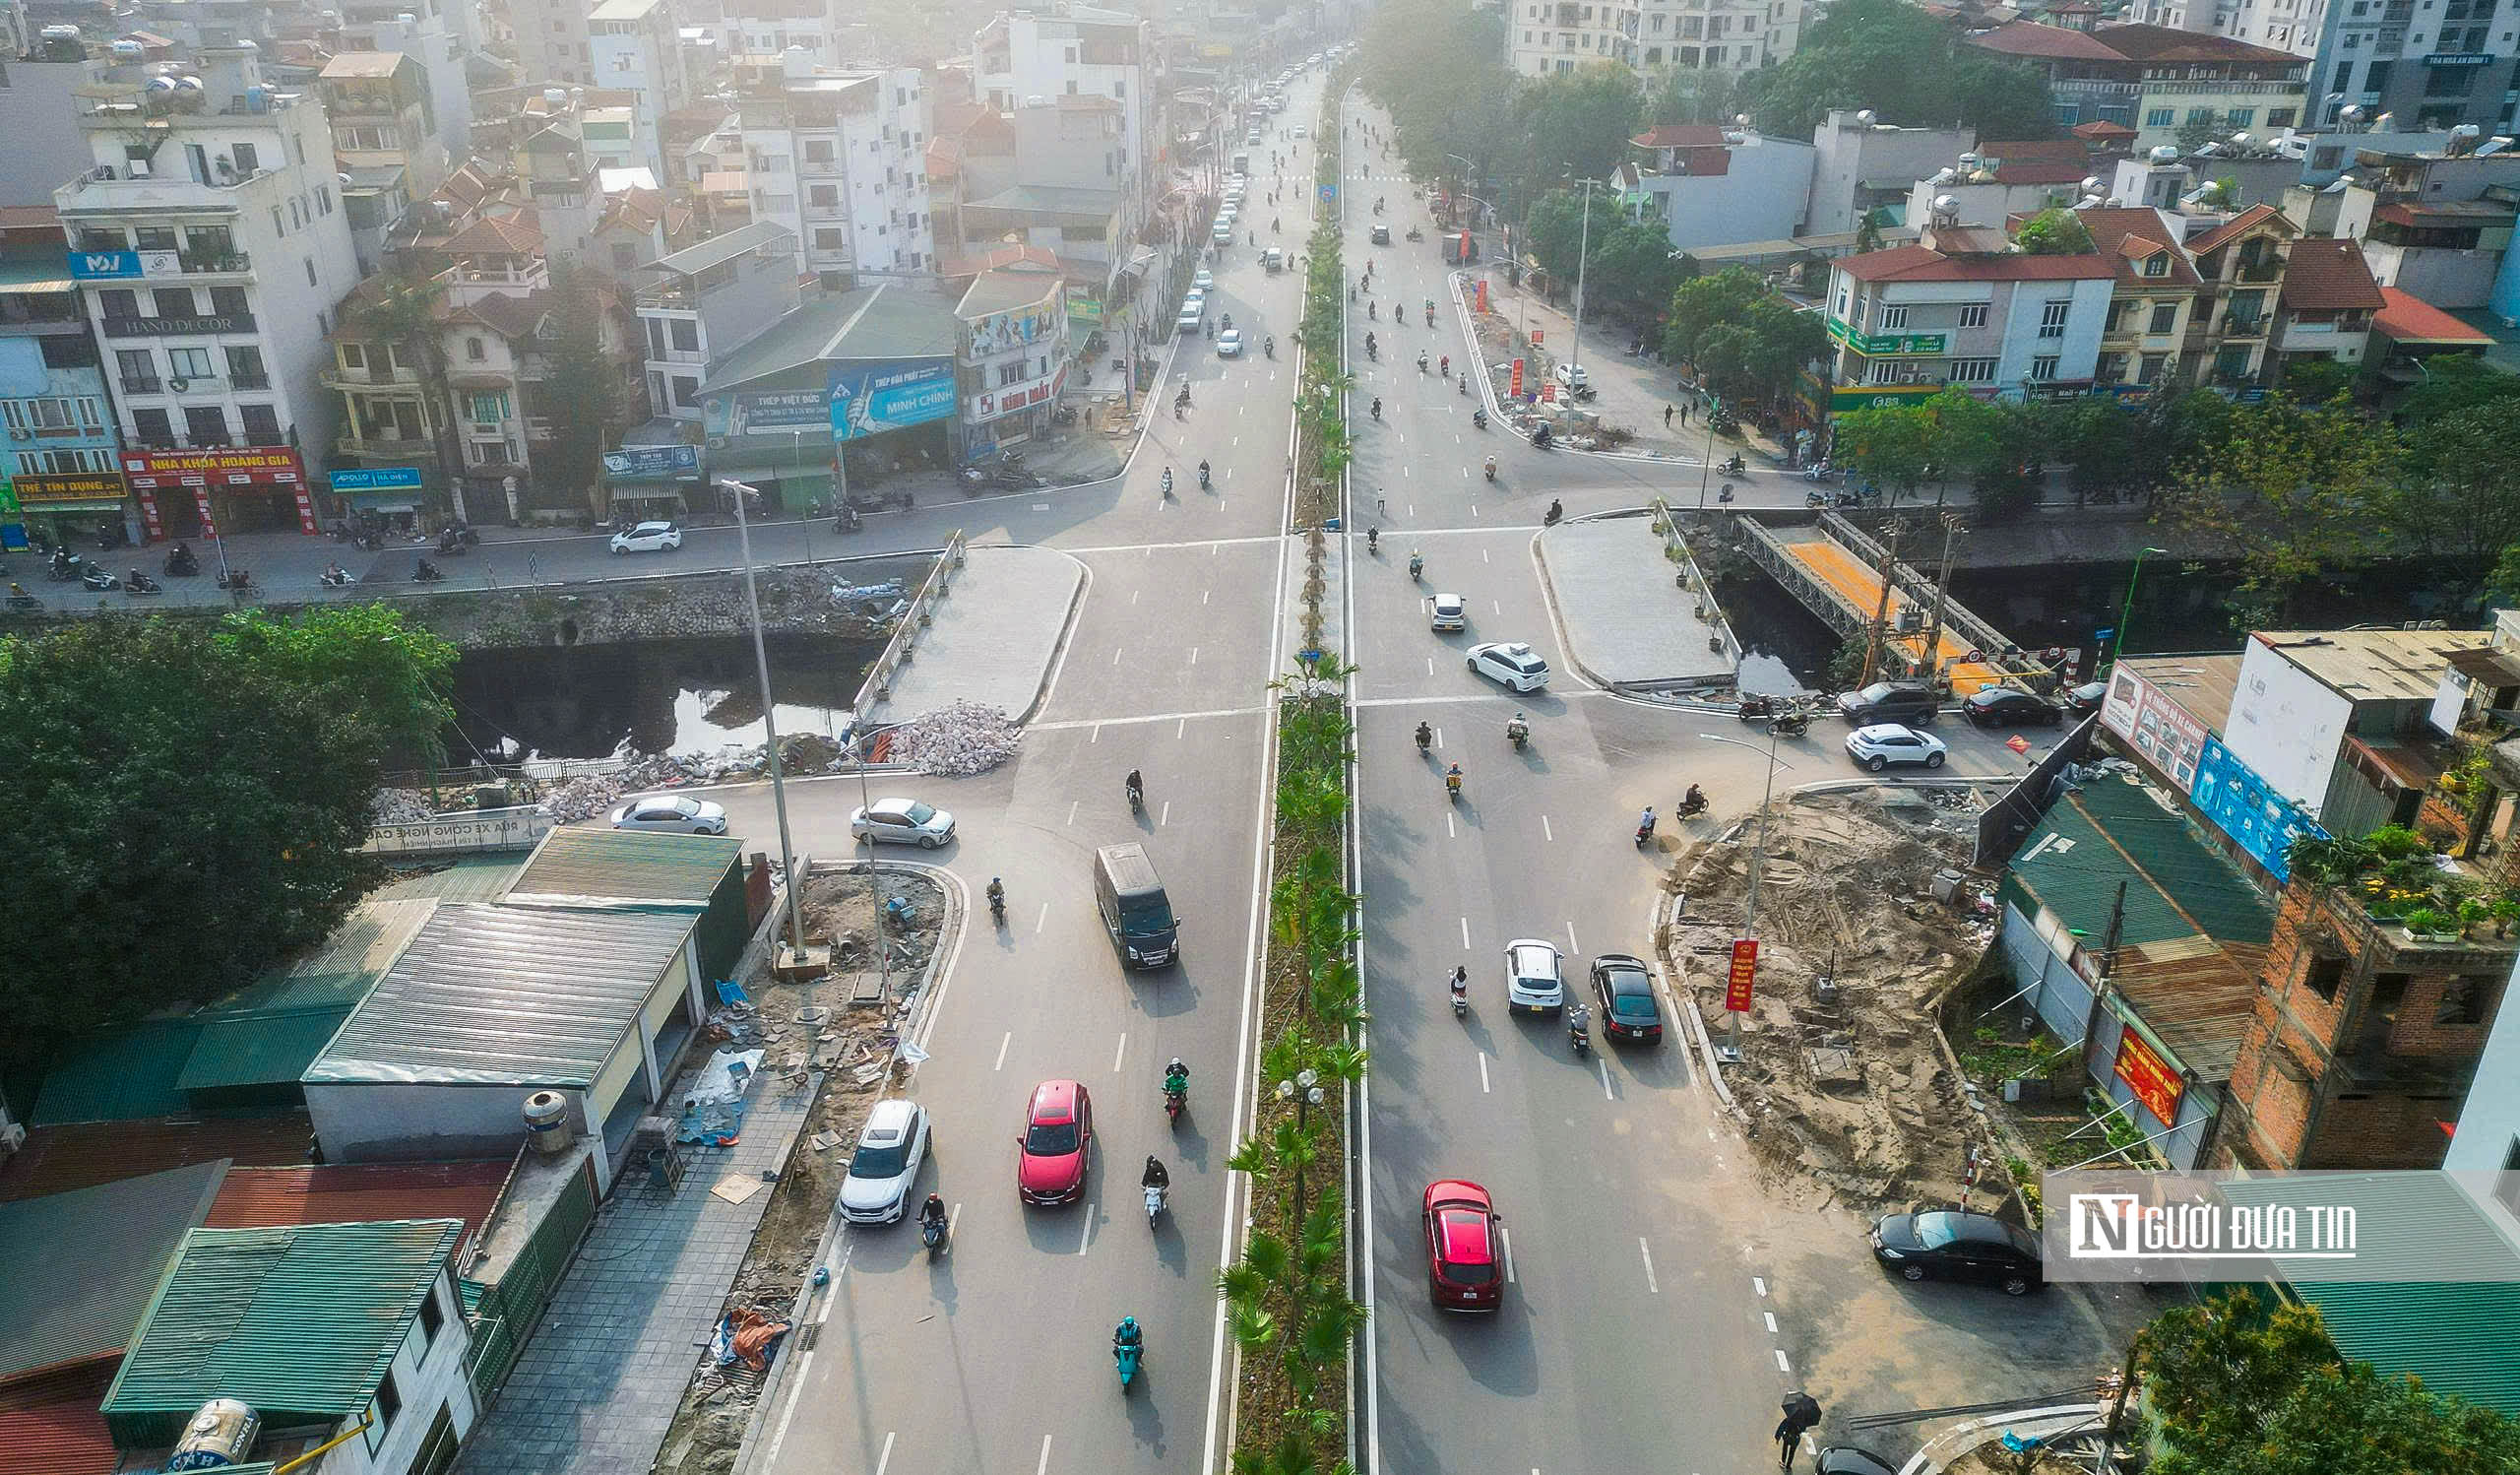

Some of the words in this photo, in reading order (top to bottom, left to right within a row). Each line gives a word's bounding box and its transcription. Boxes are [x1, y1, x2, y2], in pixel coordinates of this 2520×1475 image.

[126, 321, 172, 333] HAND
[152, 459, 178, 470] NHA
[183, 457, 218, 469] KHOA
[268, 455, 291, 466] GIA
